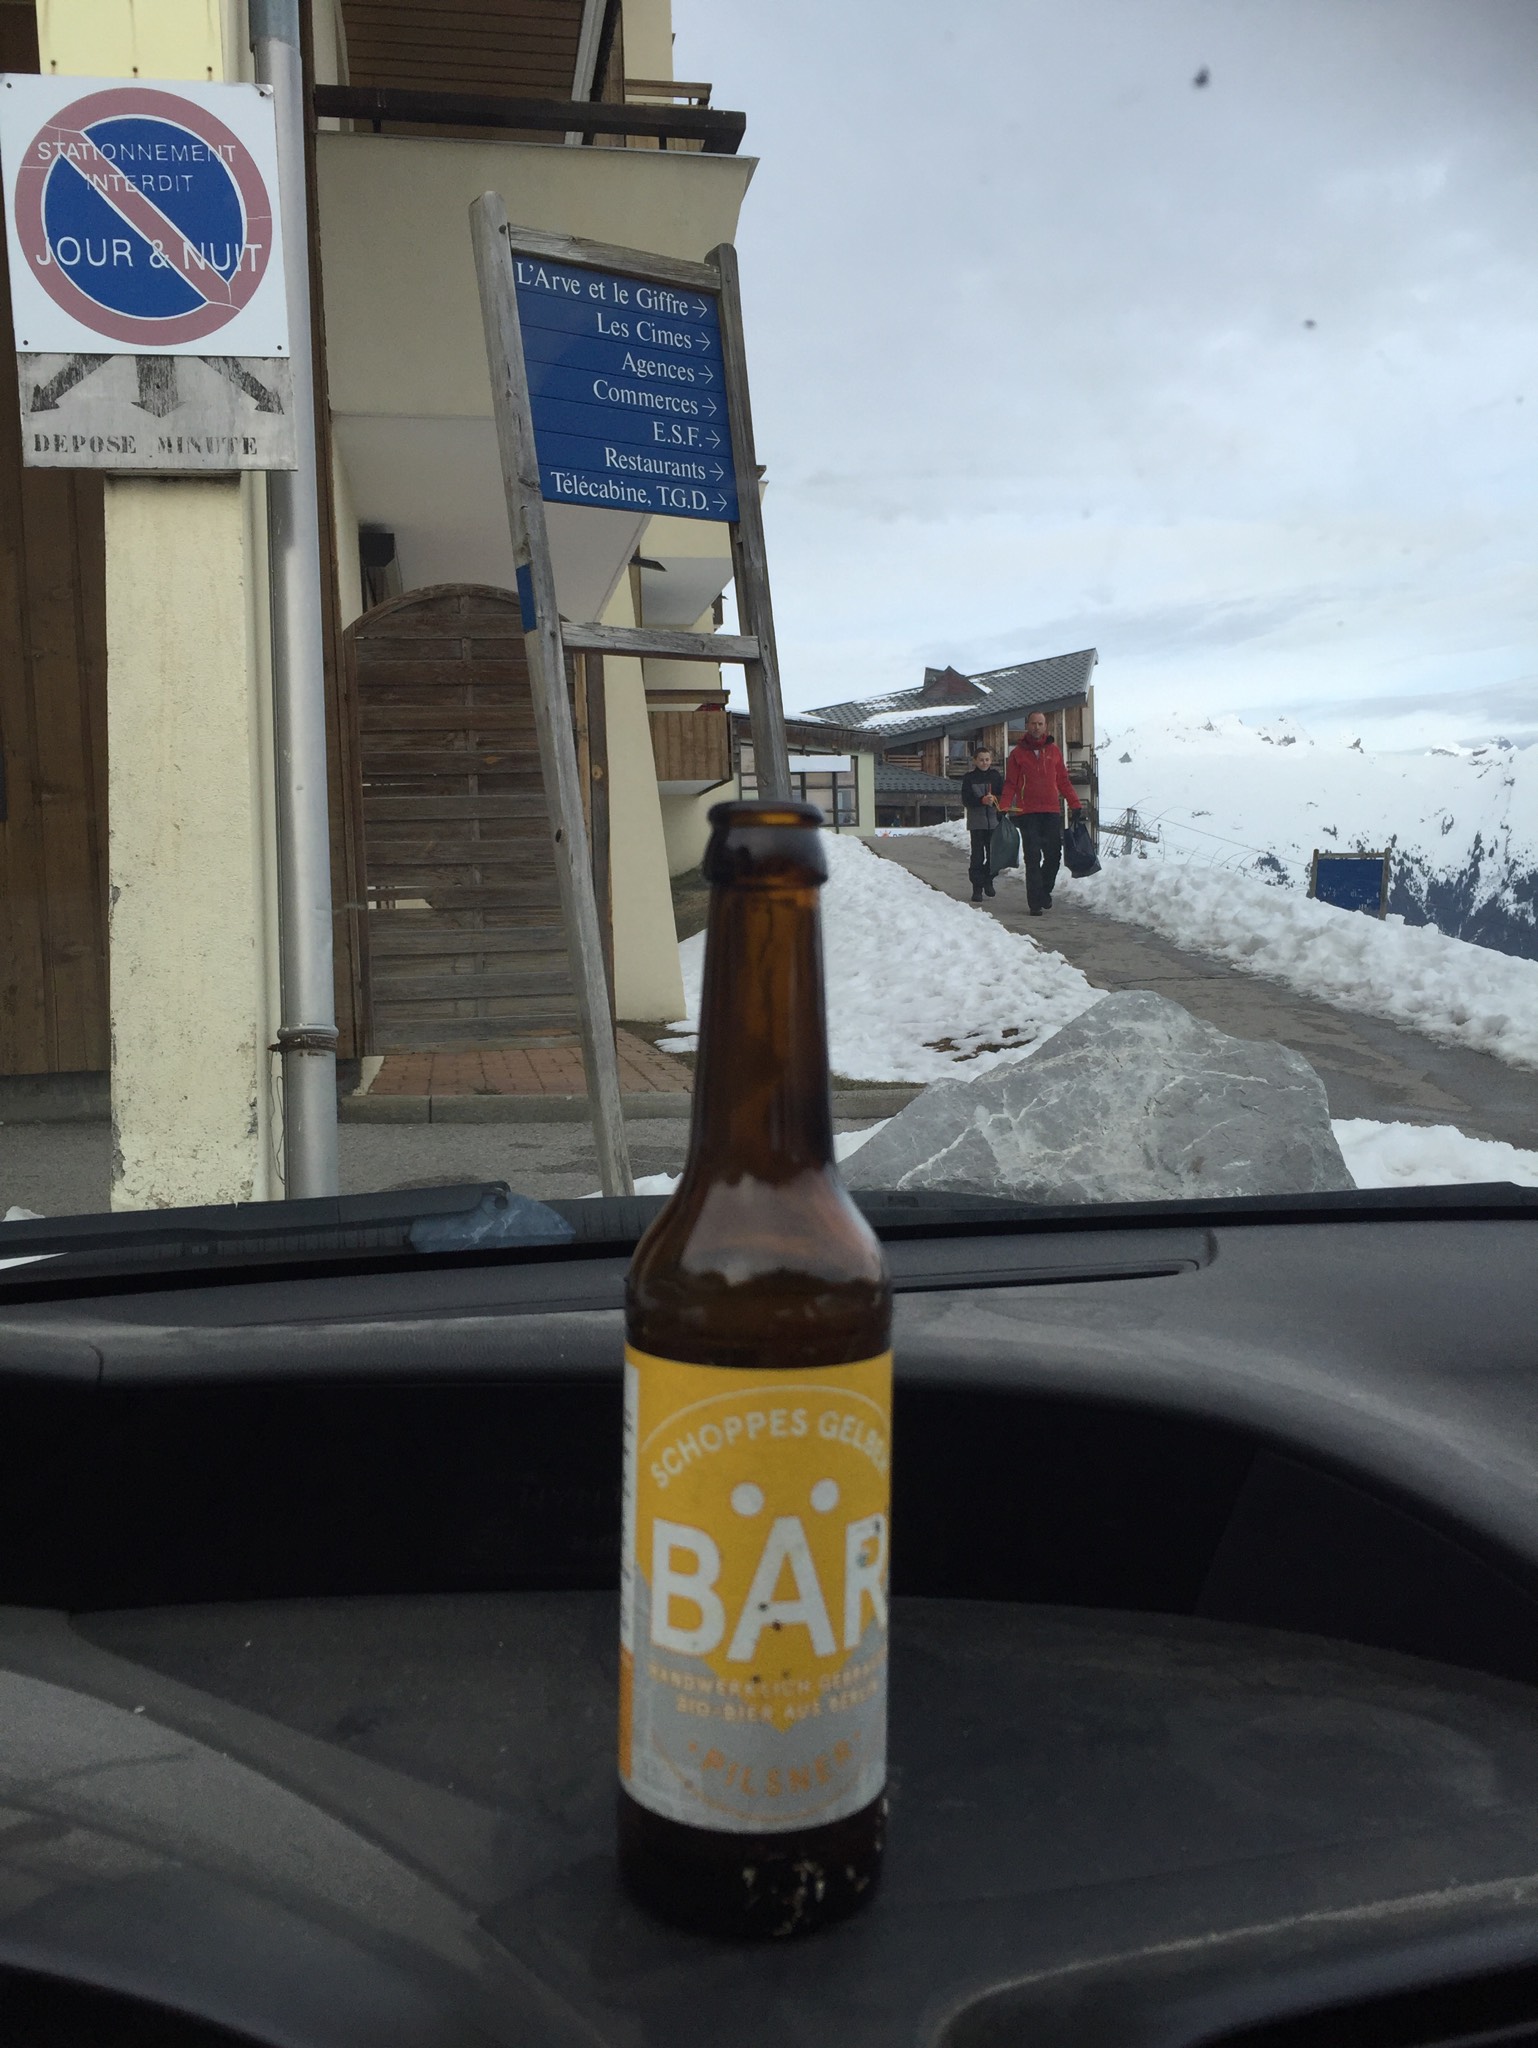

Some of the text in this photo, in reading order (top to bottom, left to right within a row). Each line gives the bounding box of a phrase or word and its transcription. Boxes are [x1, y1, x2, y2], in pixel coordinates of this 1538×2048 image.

[37, 142, 236, 163] STATIONNEMENT
[86, 173, 194, 193] INTERDIT
[35, 236, 262, 272] JOUR & NUIT
[516, 262, 689, 316] L'Arve et le Giffre
[596, 312, 692, 349] Les Cimes
[621, 352, 695, 382] Agences
[593, 379, 699, 415] Commerces
[34, 434, 258, 456] DEPOSE MINUTE
[652, 421, 703, 448] E.S.F.
[604, 447, 706, 480] Restaurants
[551, 472, 710, 511] Télécabine, T.G.D.
[650, 1408, 808, 1489] SCHOPPES
